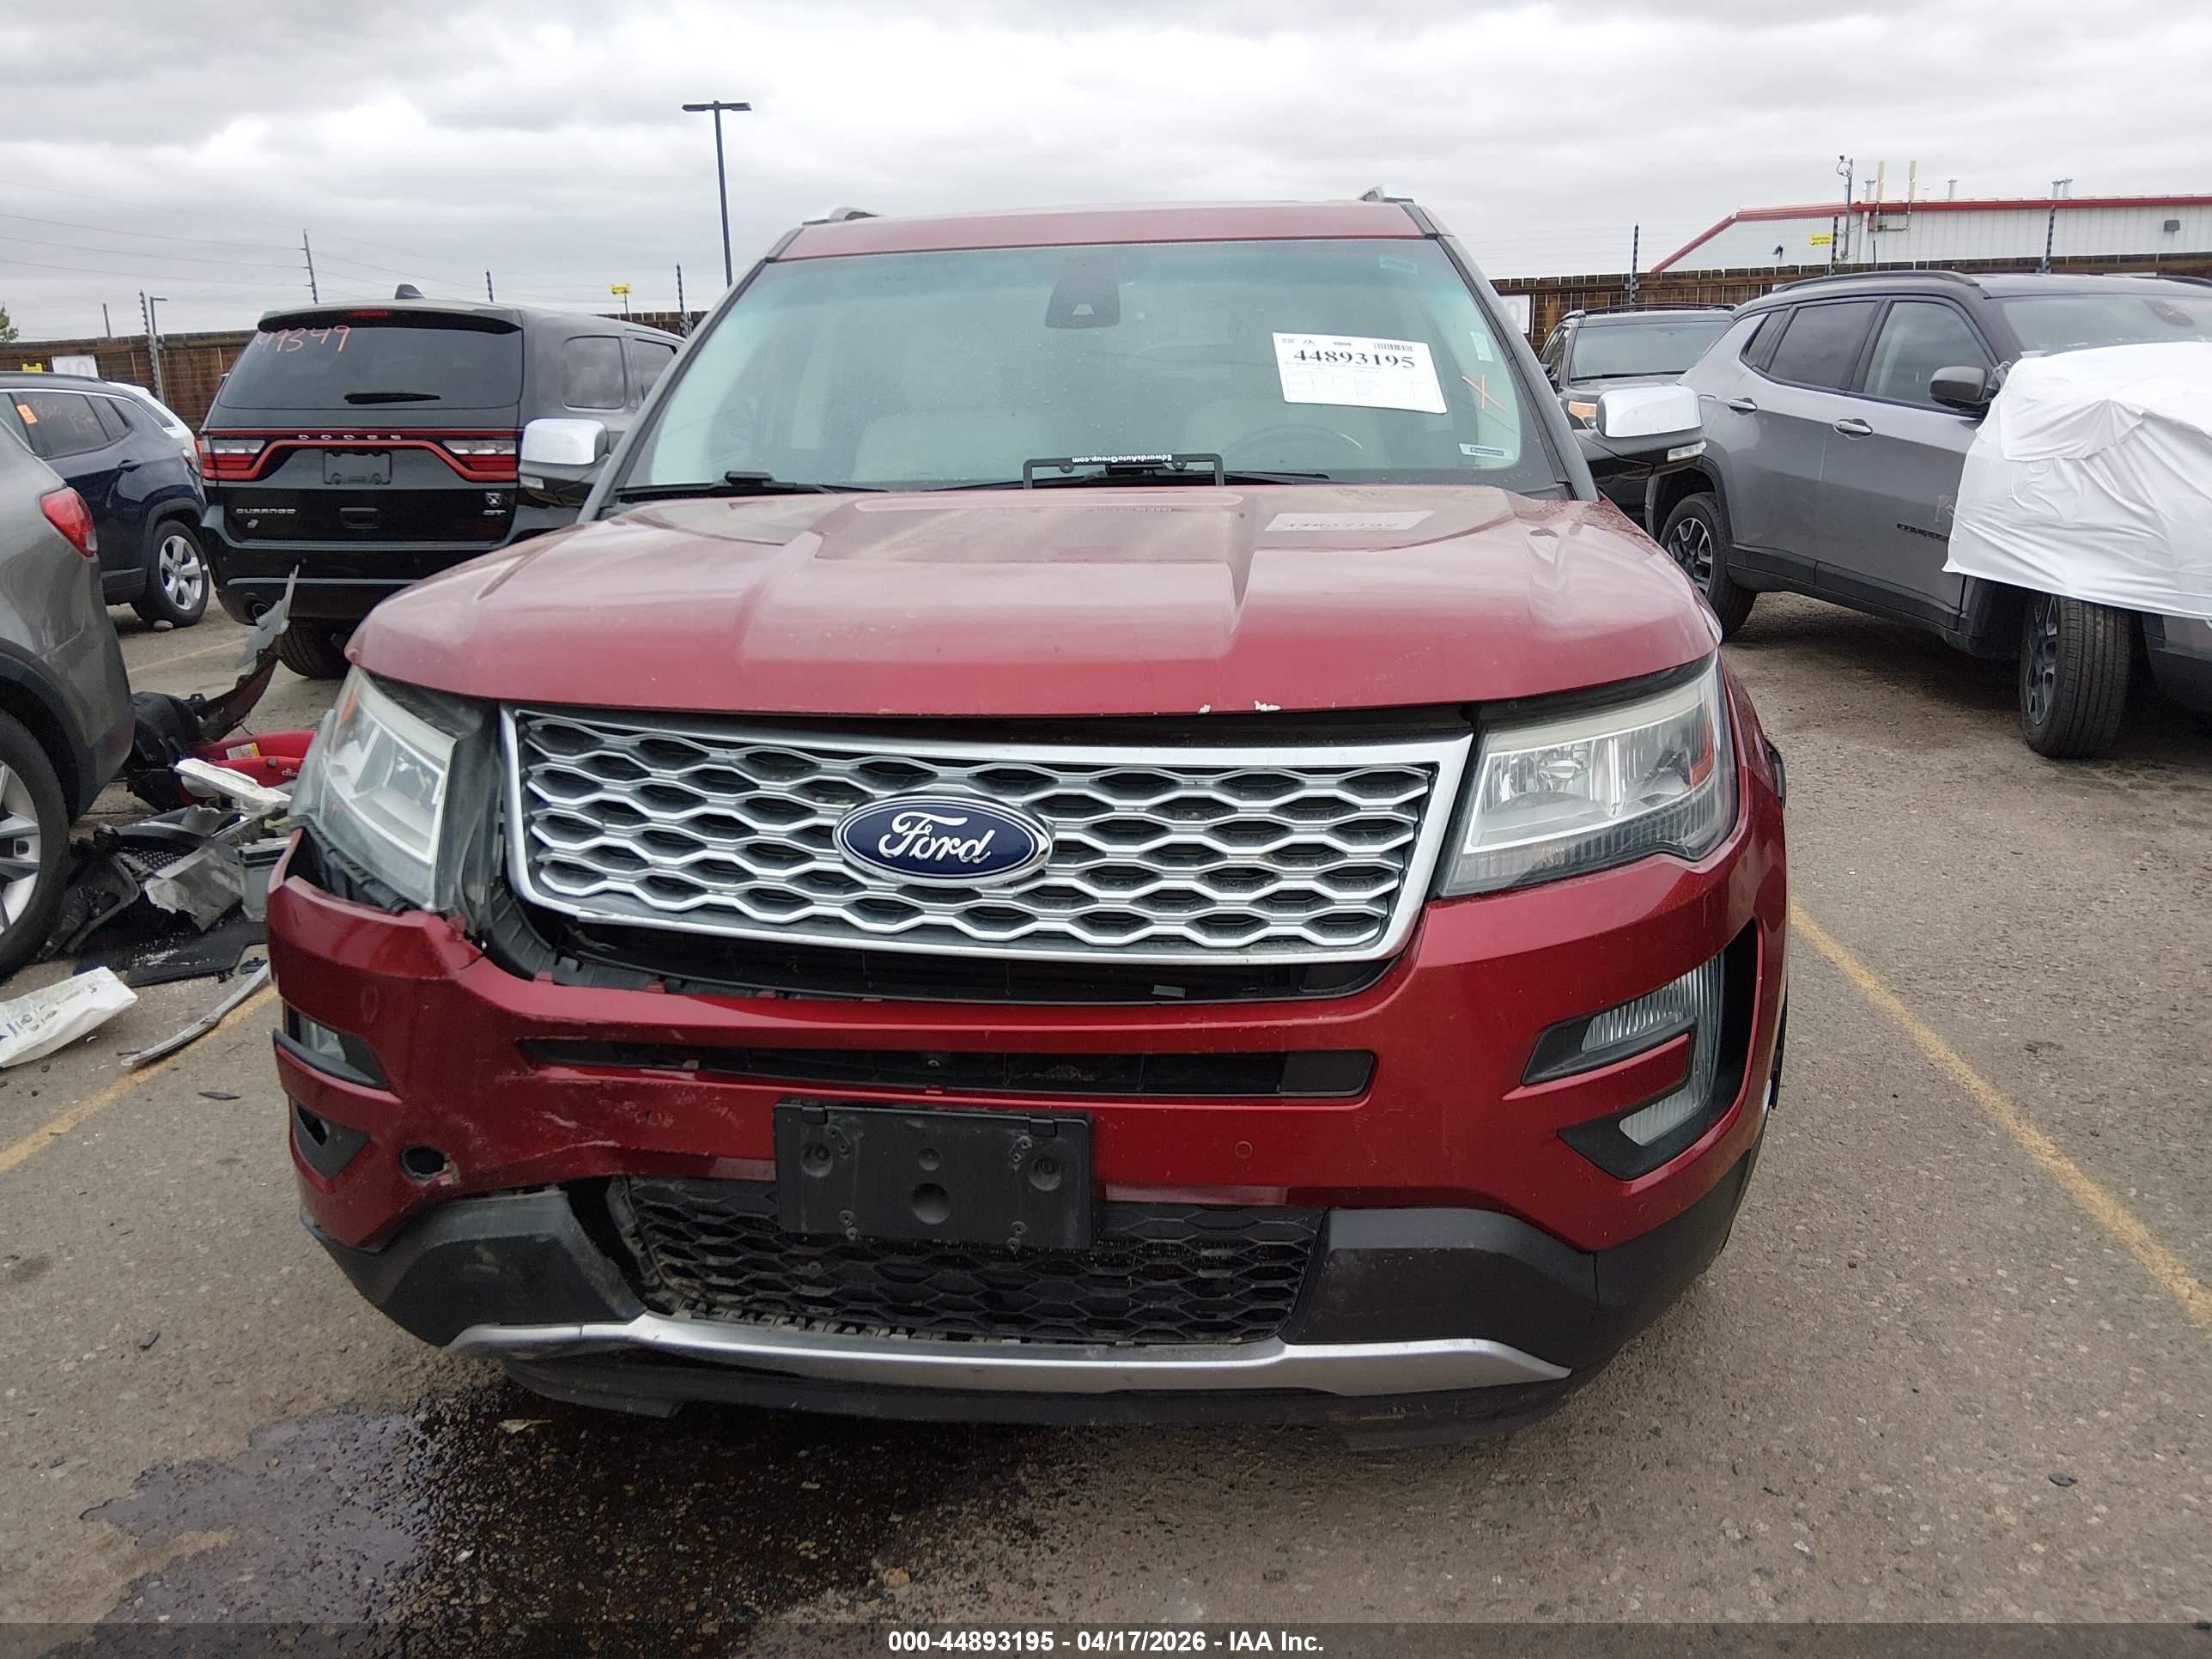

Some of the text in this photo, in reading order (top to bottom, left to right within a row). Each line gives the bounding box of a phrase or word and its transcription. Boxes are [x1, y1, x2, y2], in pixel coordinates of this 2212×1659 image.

[1293, 349, 1416, 369] 44893195
[1072, 453, 1172, 464] EdwardsAutoGroup.com
[878, 811, 996, 863] Ford
